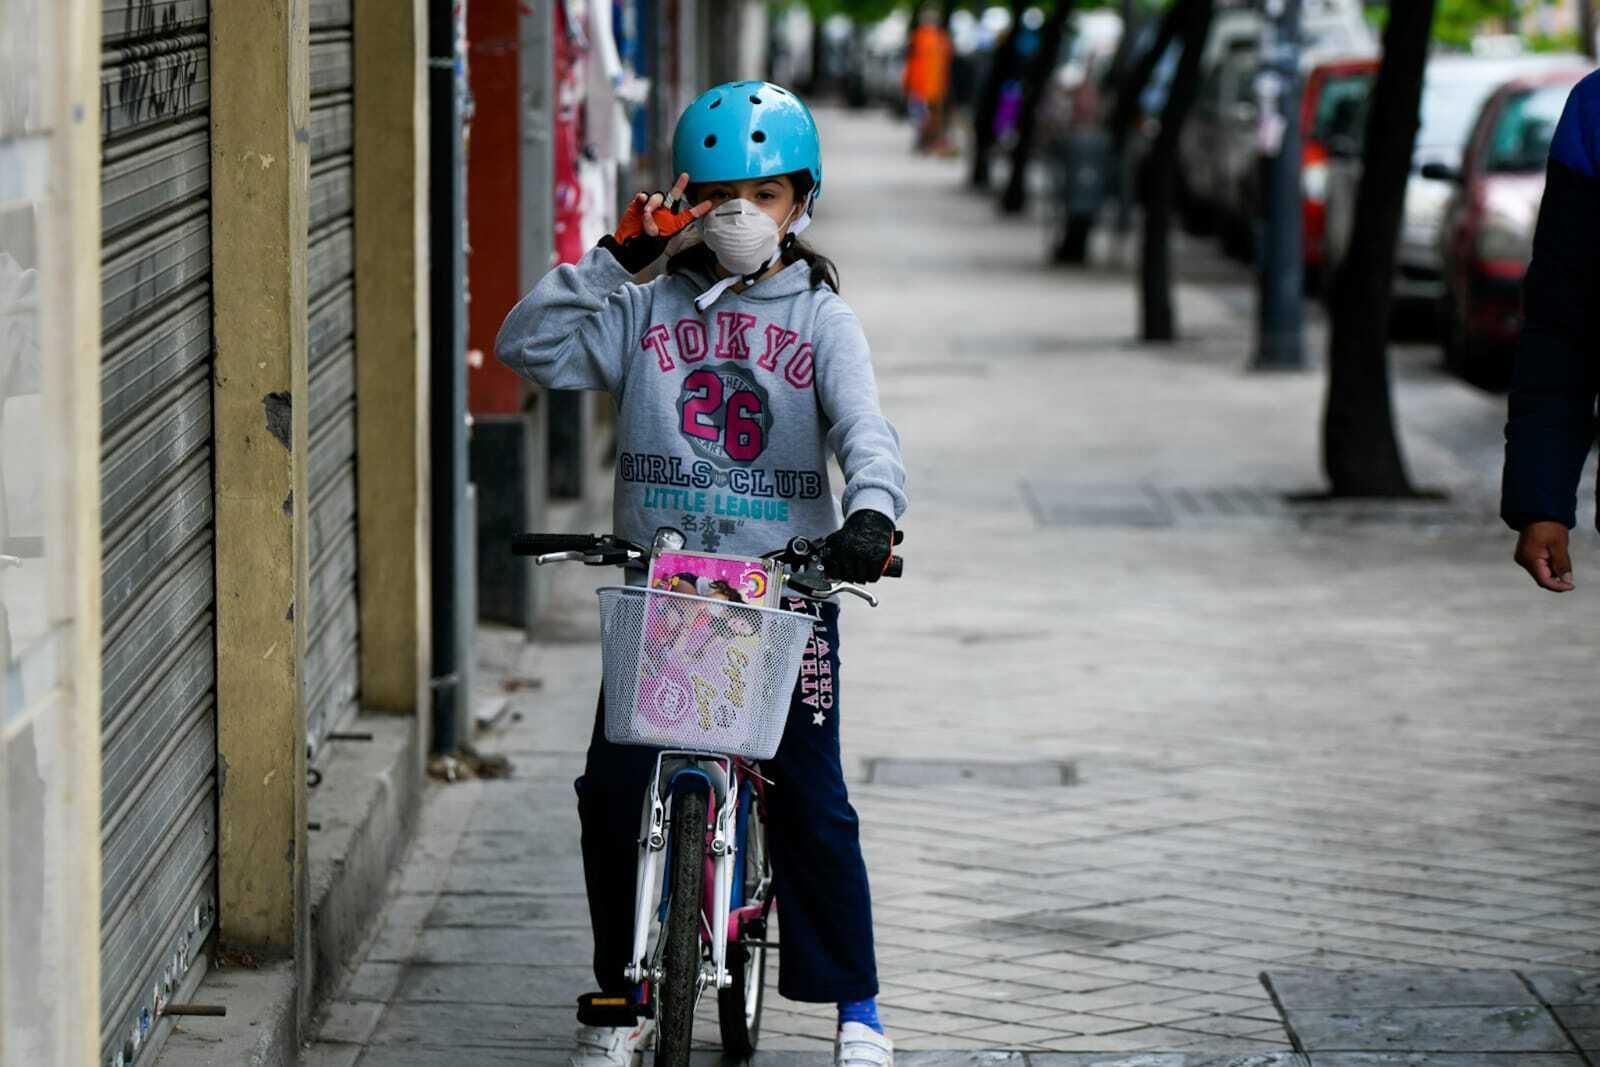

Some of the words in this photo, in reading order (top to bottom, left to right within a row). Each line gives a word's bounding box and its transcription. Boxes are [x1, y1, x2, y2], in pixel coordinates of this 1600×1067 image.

[641, 311, 813, 389] TOKYO
[682, 369, 763, 462] 26
[620, 452, 713, 488] GIRLS
[729, 468, 821, 500] CLUB
[643, 485, 705, 513] LITTLE
[714, 494, 789, 522] LEAGUE
[817, 637, 833, 709] CREW
